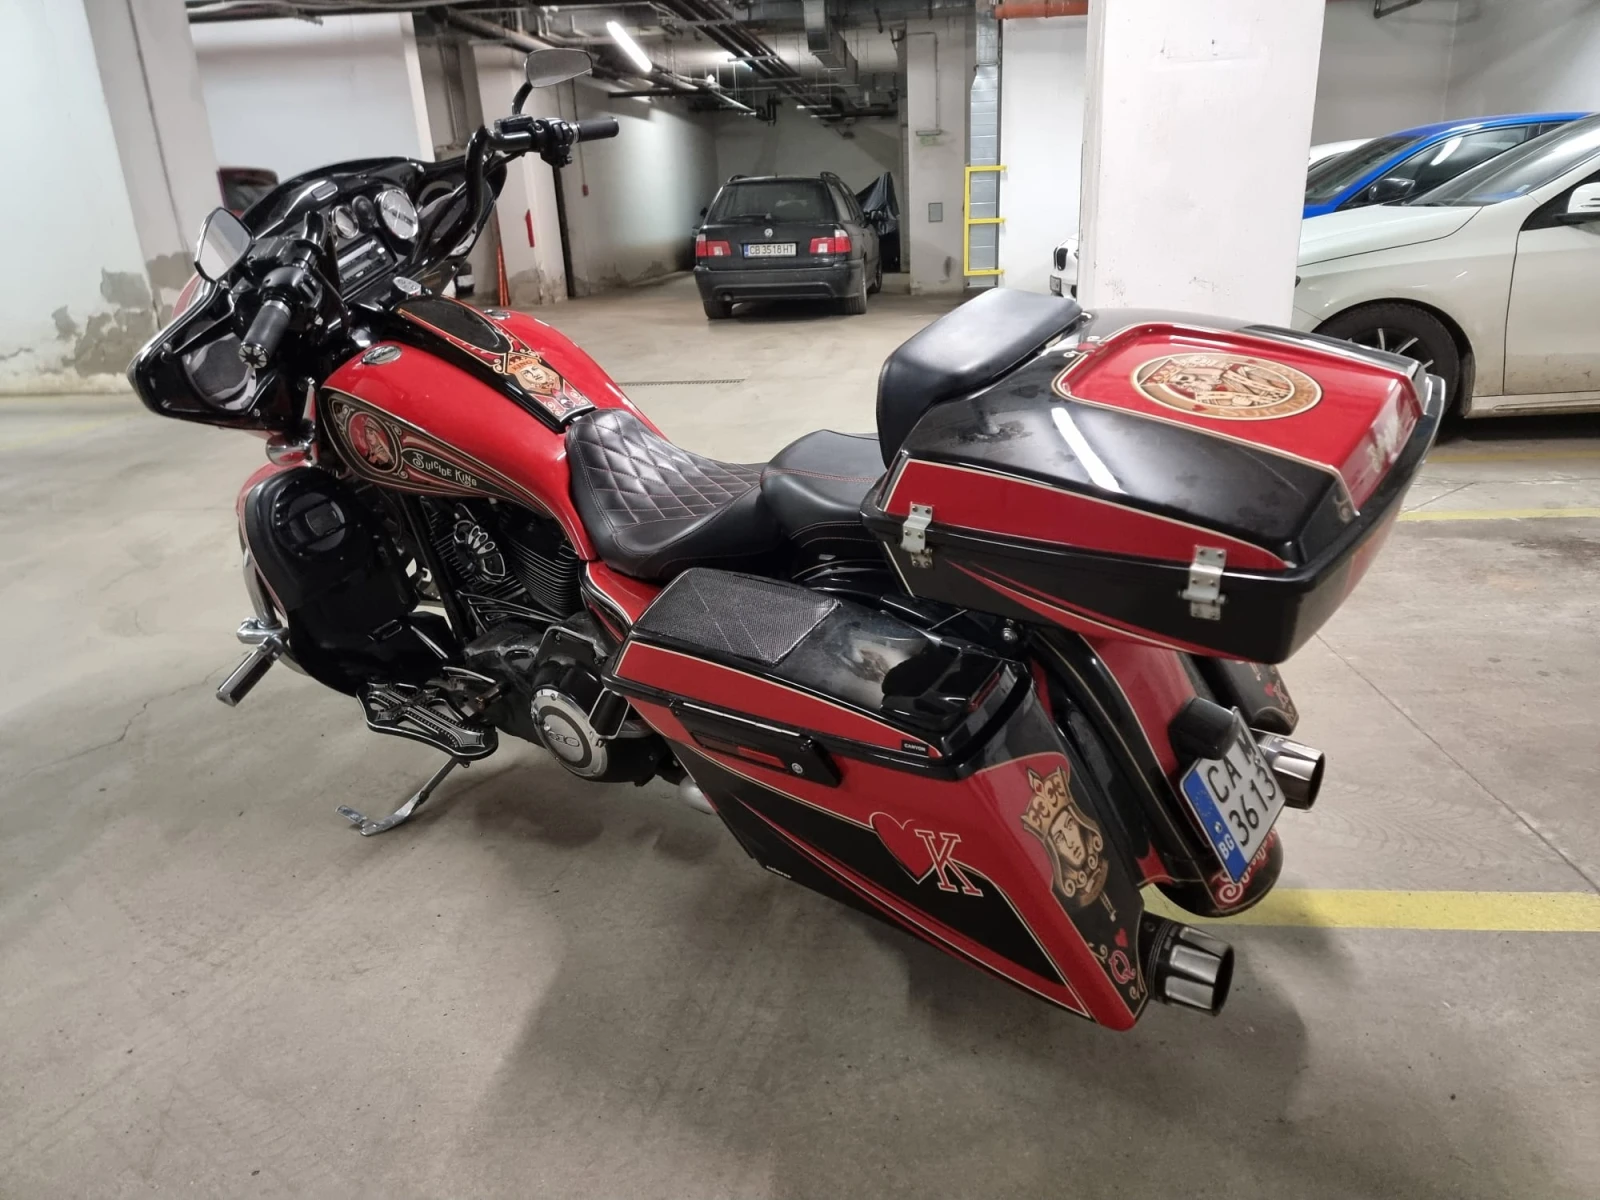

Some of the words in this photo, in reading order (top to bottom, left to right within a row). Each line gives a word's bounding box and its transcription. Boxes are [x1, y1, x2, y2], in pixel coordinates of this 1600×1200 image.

[749, 245, 761, 255] CB
[762, 244, 782, 255] 3518
[783, 244, 794, 254] HT
[1207, 756, 1243, 804] CA
[1229, 763, 1277, 847] 3613
[914, 829, 984, 897] K
[1218, 833, 1236, 861] BG
[1108, 950, 1137, 984] Q
